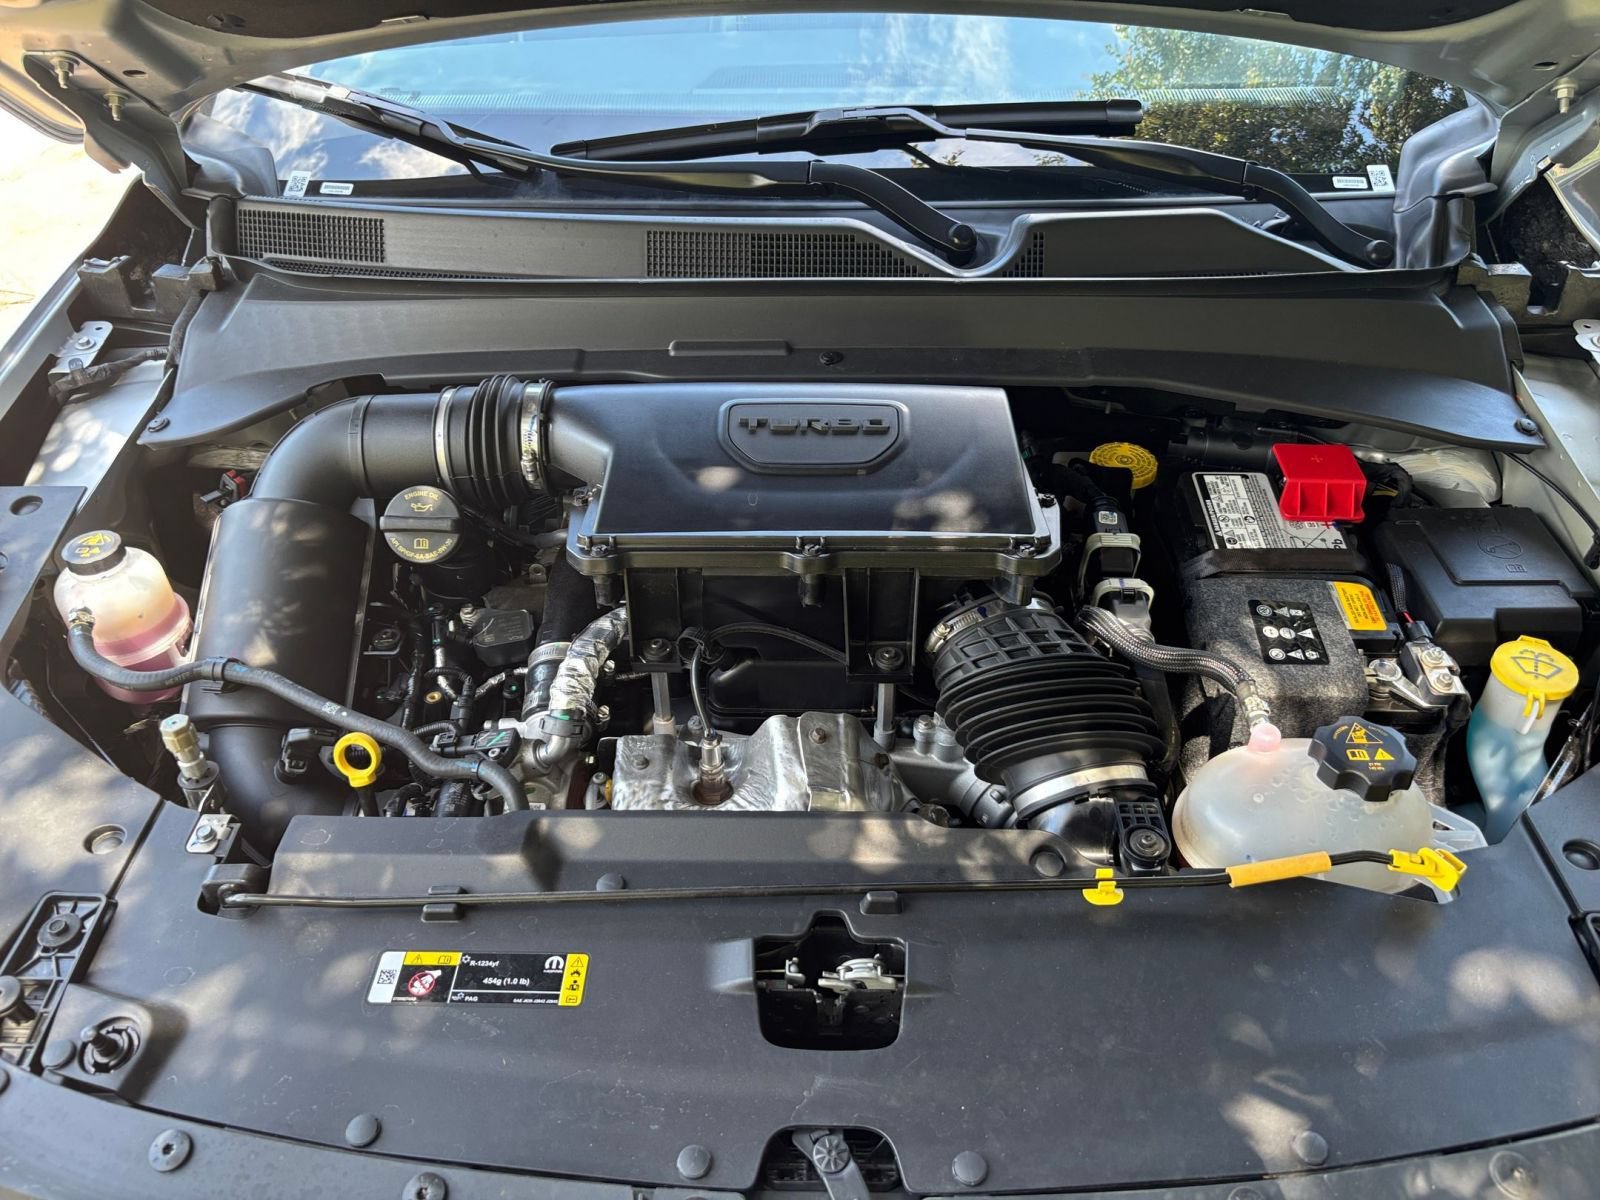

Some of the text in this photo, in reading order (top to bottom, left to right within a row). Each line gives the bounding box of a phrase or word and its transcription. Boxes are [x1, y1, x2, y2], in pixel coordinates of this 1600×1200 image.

[739, 417, 890, 435] TURBO
[404, 491, 439, 500] ENGINE OIL
[470, 960, 499, 968] R-1234yf
[482, 977, 530, 987] 454g (1.0 lb)
